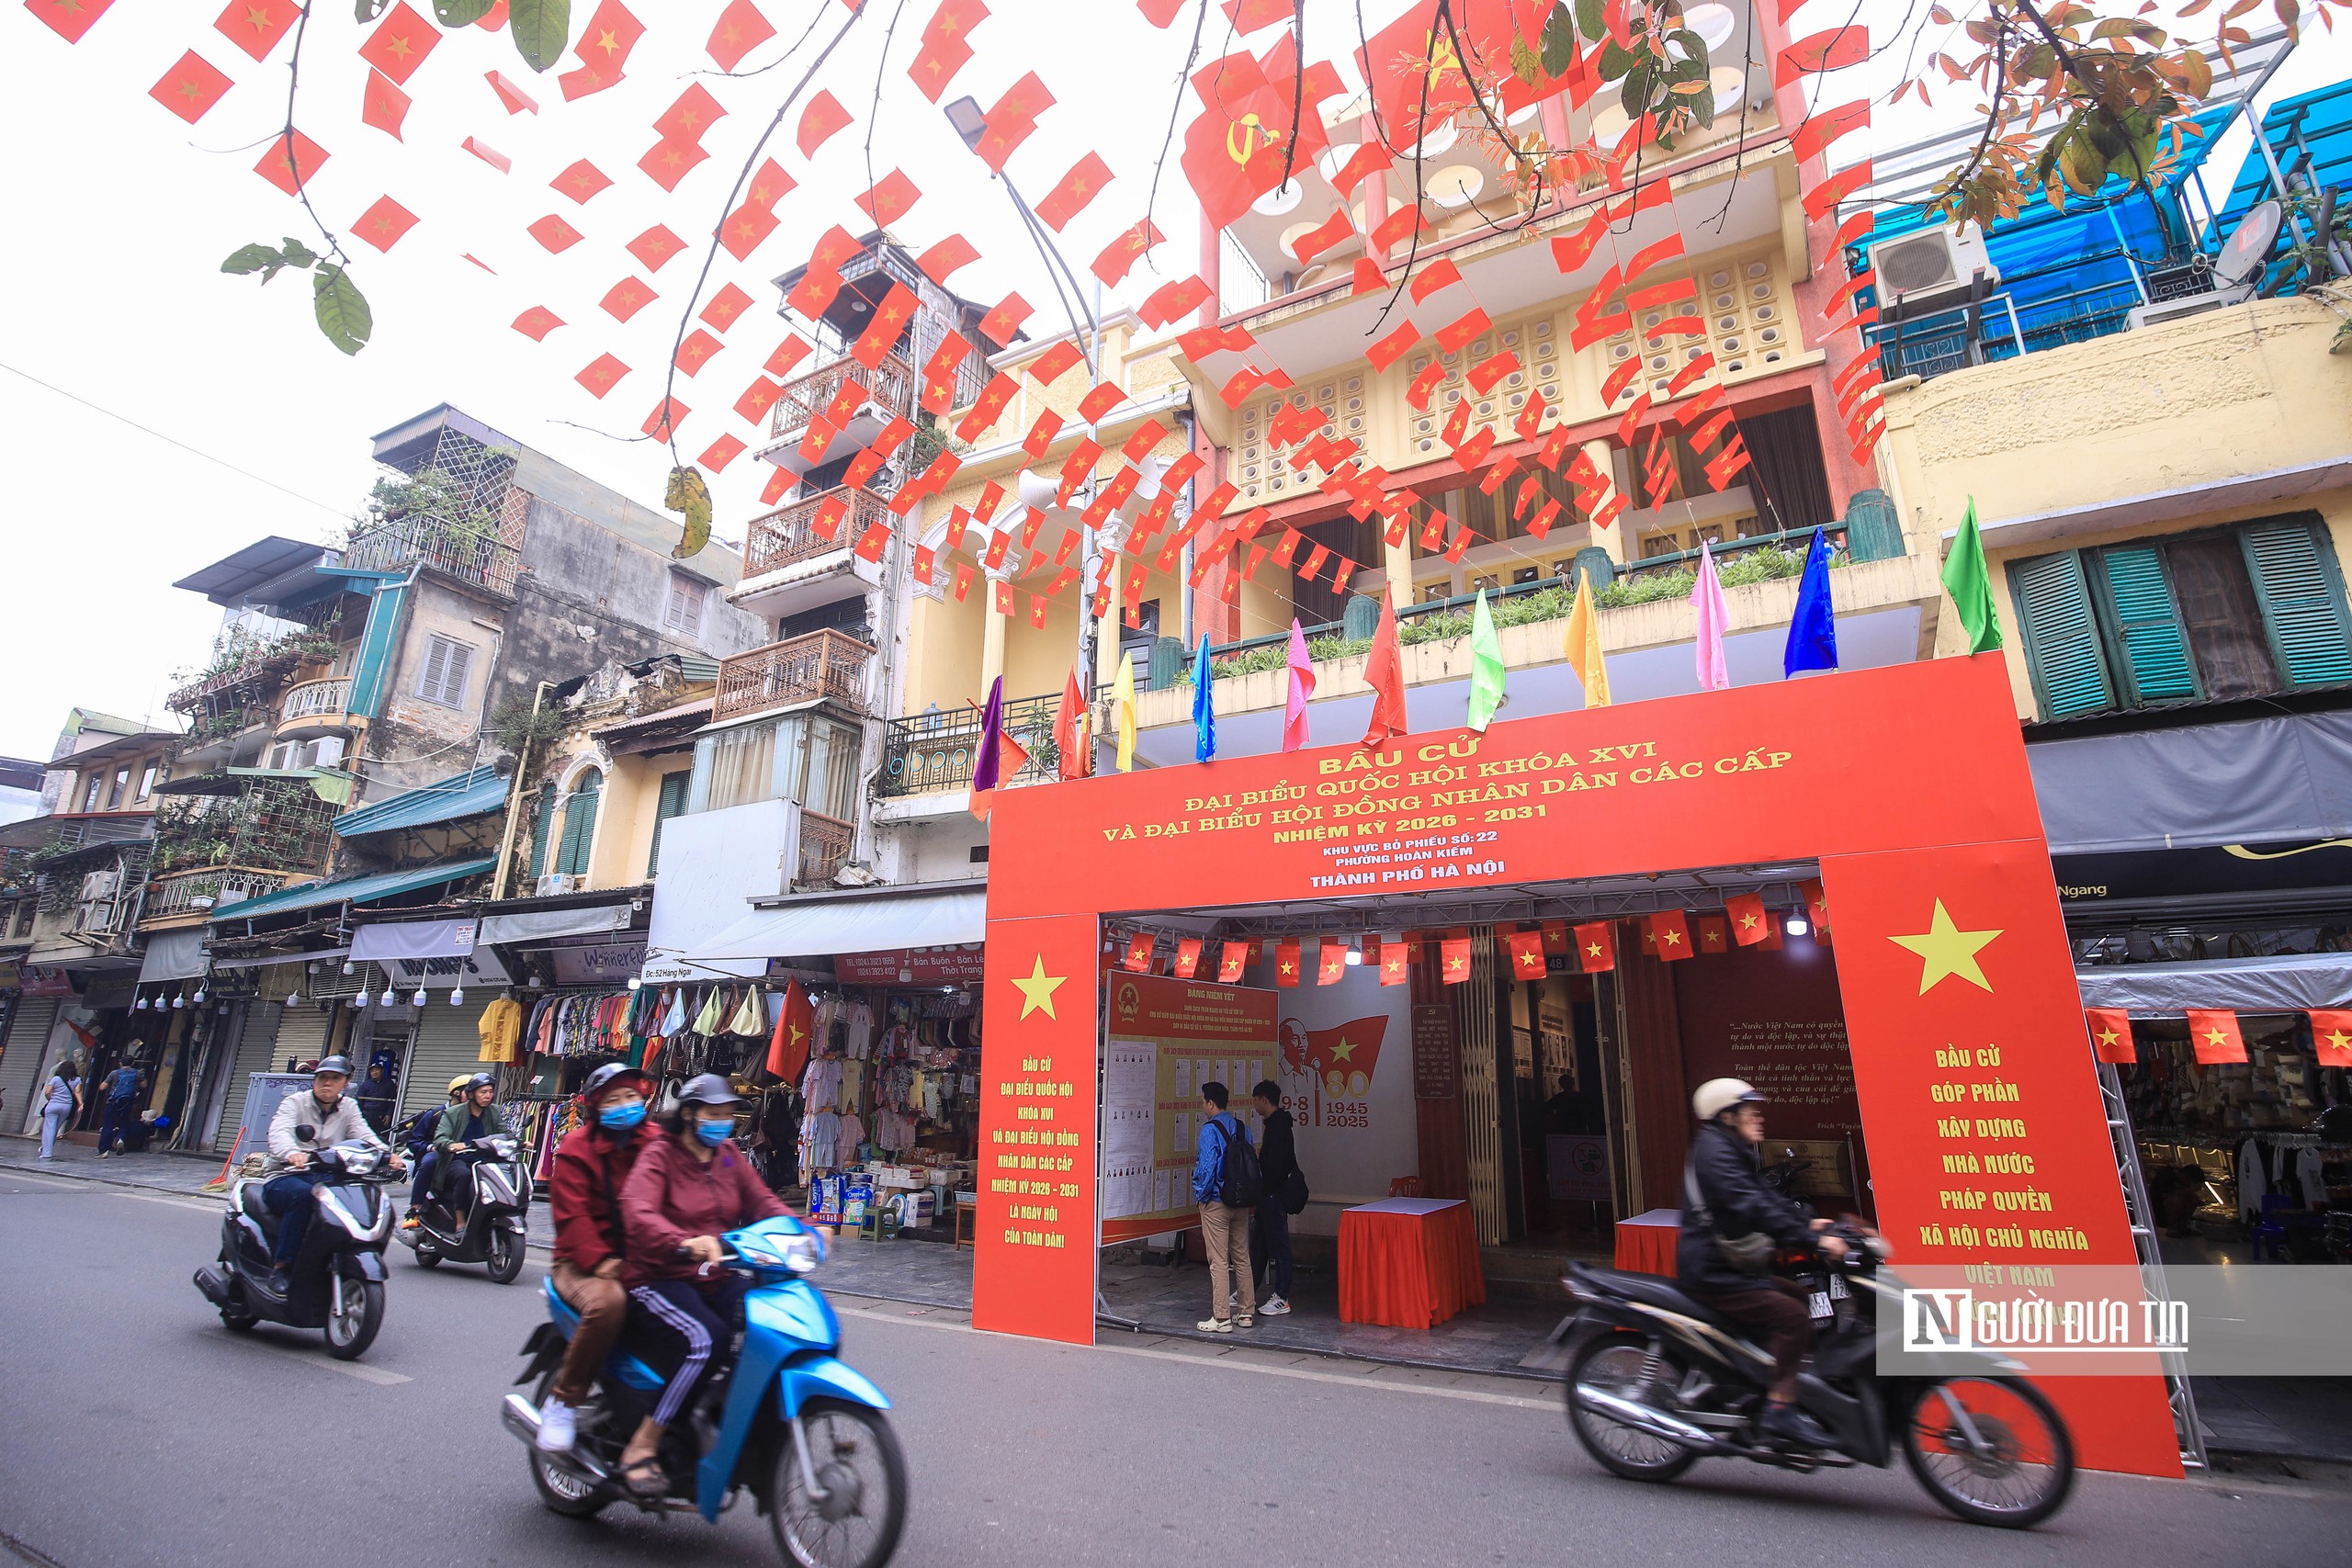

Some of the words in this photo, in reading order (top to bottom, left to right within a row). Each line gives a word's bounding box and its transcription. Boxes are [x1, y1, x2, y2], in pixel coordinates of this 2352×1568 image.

[1318, 748, 1402, 774] BẦU
[1418, 734, 1482, 761] CỬ
[1185, 794, 1233, 812] ĐẠI
[1240, 779, 1307, 806] BIỂU
[1316, 770, 1400, 796] QUỐC
[1408, 764, 1467, 786] HỘI
[1477, 751, 1578, 778] KHÓA
[1589, 741, 1657, 763] XVI
[1102, 823, 1136, 841] VÀ
[1144, 820, 1191, 839] ĐẠI
[1198, 807, 1262, 832] BIỂU
[1271, 804, 1324, 825] HỘI
[1332, 794, 1423, 818] ĐỒNG
[1430, 782, 1530, 807] NHÂN
[1540, 772, 1619, 795] DÂN
[1629, 761, 1704, 784] CÁC
[1713, 746, 1792, 774] CẤP
[1273, 825, 1349, 844] NHIỆM
[1357, 819, 1388, 836] KỲ
[1396, 814, 1457, 832] 2026
[1484, 804, 1547, 823] 2031
[1323, 845, 1350, 856] KHU
[1353, 842, 1379, 854] VỰC
[1383, 839, 1401, 852] BỎ
[1405, 834, 1447, 850] PHIẾU
[1335, 853, 1390, 867] PHƯỜNG
[1394, 848, 1432, 863] HOÀN
[1436, 845, 1473, 858] KIẾM
[1310, 870, 1376, 888] THÀNH
[1382, 863, 1425, 883] PHỐ
[1430, 863, 1460, 878] HÀ
[1466, 859, 1506, 876] NỘI
[2058, 885, 2108, 898] Ngang
[913, 957, 929, 966] Bán
[931, 956, 950, 965] Buôn
[956, 955, 972, 964] Bán
[941, 966, 958, 975] Thời
[959, 965, 983, 976] Trang
[1549, 958, 1563, 969] 48
[1187, 988, 1205, 998] BẢNG
[1224, 990, 1235, 1001] YẾT
[1766, 1021, 1781, 1031] Việt
[1806, 1021, 1815, 1029] có
[1818, 1018, 1843, 1030] quyền
[1022, 1054, 1038, 1072] BẦU
[1040, 1055, 1052, 1072] CỬ
[1935, 1043, 1972, 1068] BẦU
[1975, 1043, 2001, 1067] CỬ
[1001, 1082, 1014, 1099] ĐẠI
[1015, 1077, 1034, 1096] BIỂU
[1035, 1077, 1057, 1097] QUỐC
[1058, 1080, 1073, 1100] HỘI
[1326, 1069, 1370, 1100] 80
[1930, 1080, 1966, 1103] GÓP
[1971, 1077, 2020, 1102] PHẦN
[1017, 1104, 1039, 1121] KHÓA
[1040, 1107, 1054, 1121] XVI
[1282, 1096, 1309, 1111] 9-8
[1327, 1101, 1368, 1114] 1945
[1327, 1115, 1369, 1128] 2025
[1937, 1115, 1971, 1138] XÂY
[1975, 1117, 2027, 1142] DỰNG
[992, 1127, 1003, 1144] VÀ
[1004, 1130, 1018, 1146] ĐẠI
[1020, 1125, 1038, 1145] BIỂU
[1040, 1129, 1055, 1148] HỘI
[1057, 1127, 1080, 1146] ĐỒNG
[997, 1152, 1019, 1168] NHÂN
[1020, 1153, 1036, 1169] DÂN
[1038, 1154, 1055, 1170] CÁC
[1057, 1153, 1073, 1171] CẤP
[1941, 1151, 1981, 1174] NHÀ
[1984, 1151, 2035, 1174] NƯỚC
[991, 1177, 1017, 1196] NHIỆM
[1019, 1178, 1029, 1194] KỲ
[1030, 1181, 1050, 1196] 2026
[1059, 1183, 1080, 1198] 2031
[1939, 1187, 1987, 1210] PHÁP
[1992, 1184, 2052, 1212] QUYỀN
[1009, 1202, 1019, 1219] LÀ
[1021, 1203, 1042, 1221] NGÀY
[1044, 1204, 1058, 1224] HỘI
[1004, 1225, 1021, 1244] CỦA
[1022, 1229, 1043, 1247] TOÀN
[1045, 1231, 1065, 1248] DÂN!
[1919, 1223, 1945, 1246] XÃ
[1948, 1224, 1981, 1250] HỘI
[1985, 1223, 2024, 1247] CHỦ
[2029, 1226, 2089, 1250] NGHĨA
[1963, 1260, 2003, 1288] VIỆT
[2008, 1266, 2055, 1287] NAM
